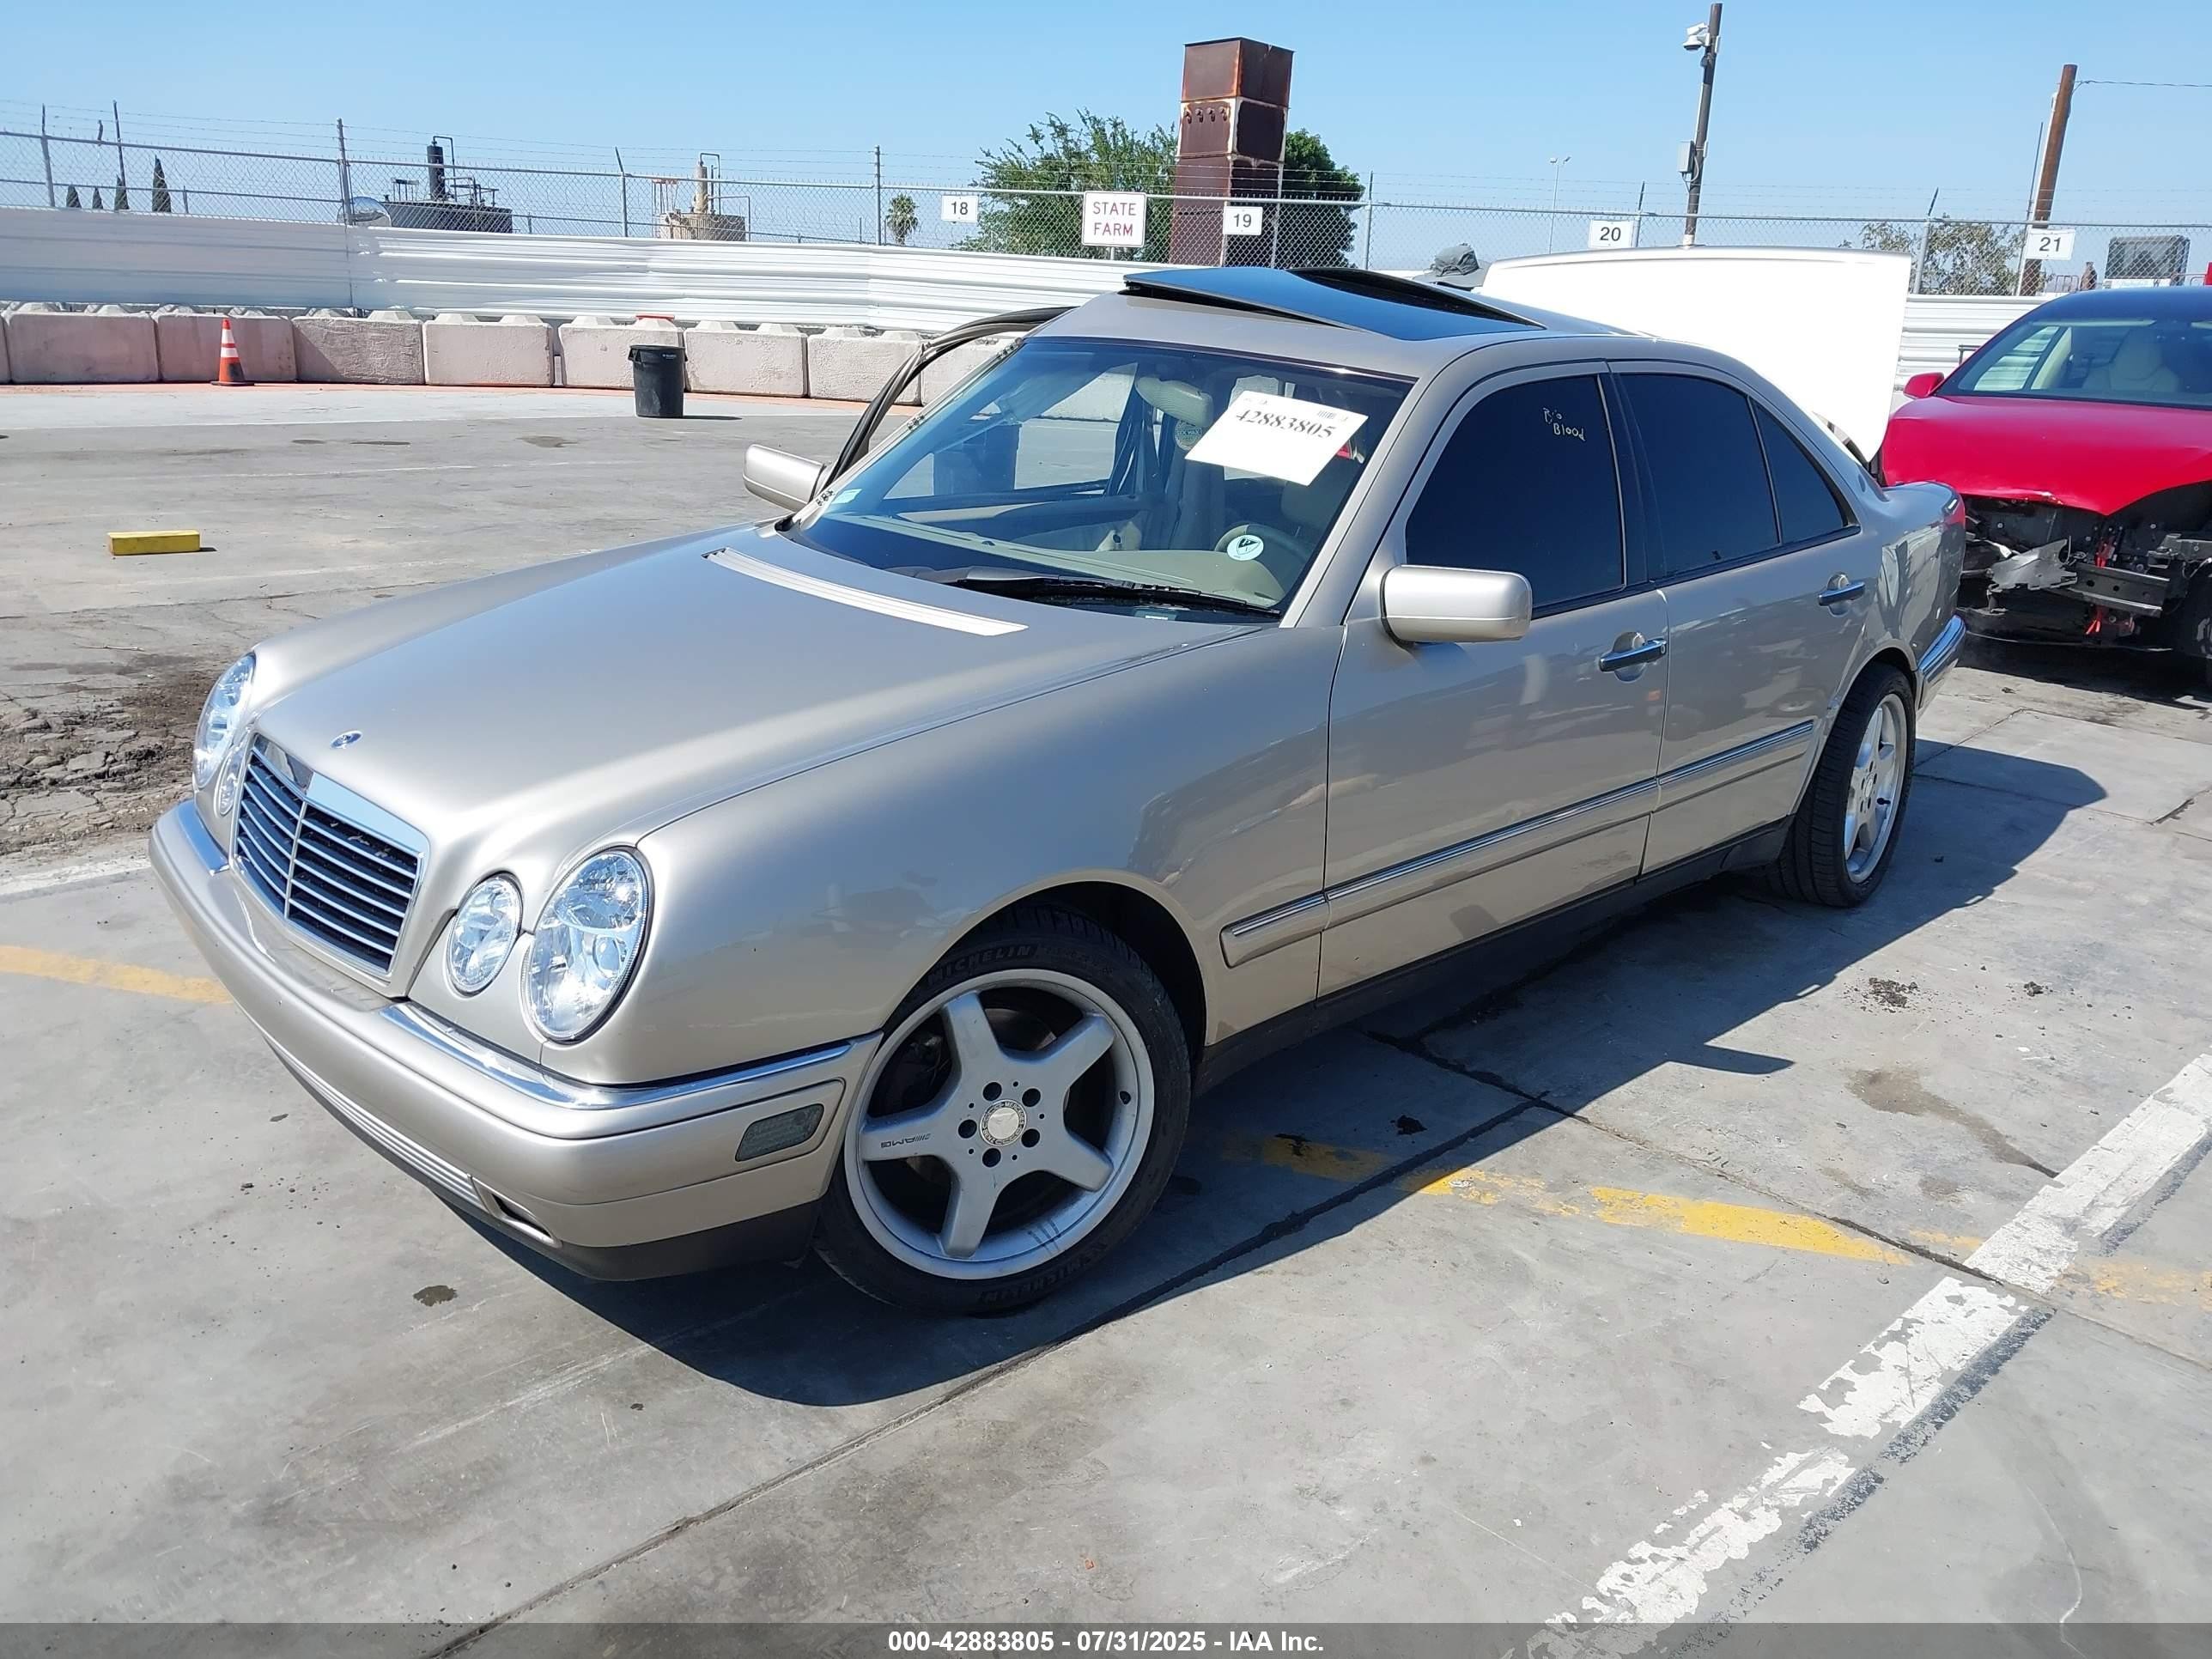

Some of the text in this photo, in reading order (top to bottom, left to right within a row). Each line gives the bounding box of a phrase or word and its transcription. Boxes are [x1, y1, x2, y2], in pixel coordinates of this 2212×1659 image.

[951, 201, 969, 216] 18
[1092, 201, 1137, 216] STATE
[1233, 212, 1253, 228] 19
[1093, 222, 1133, 236] FARM
[1600, 226, 1621, 241] 20
[2039, 236, 2062, 252] 21
[1236, 409, 1336, 439] 42883805
[1553, 422, 1586, 441] Blood
[928, 945, 1032, 982] MICHELIN
